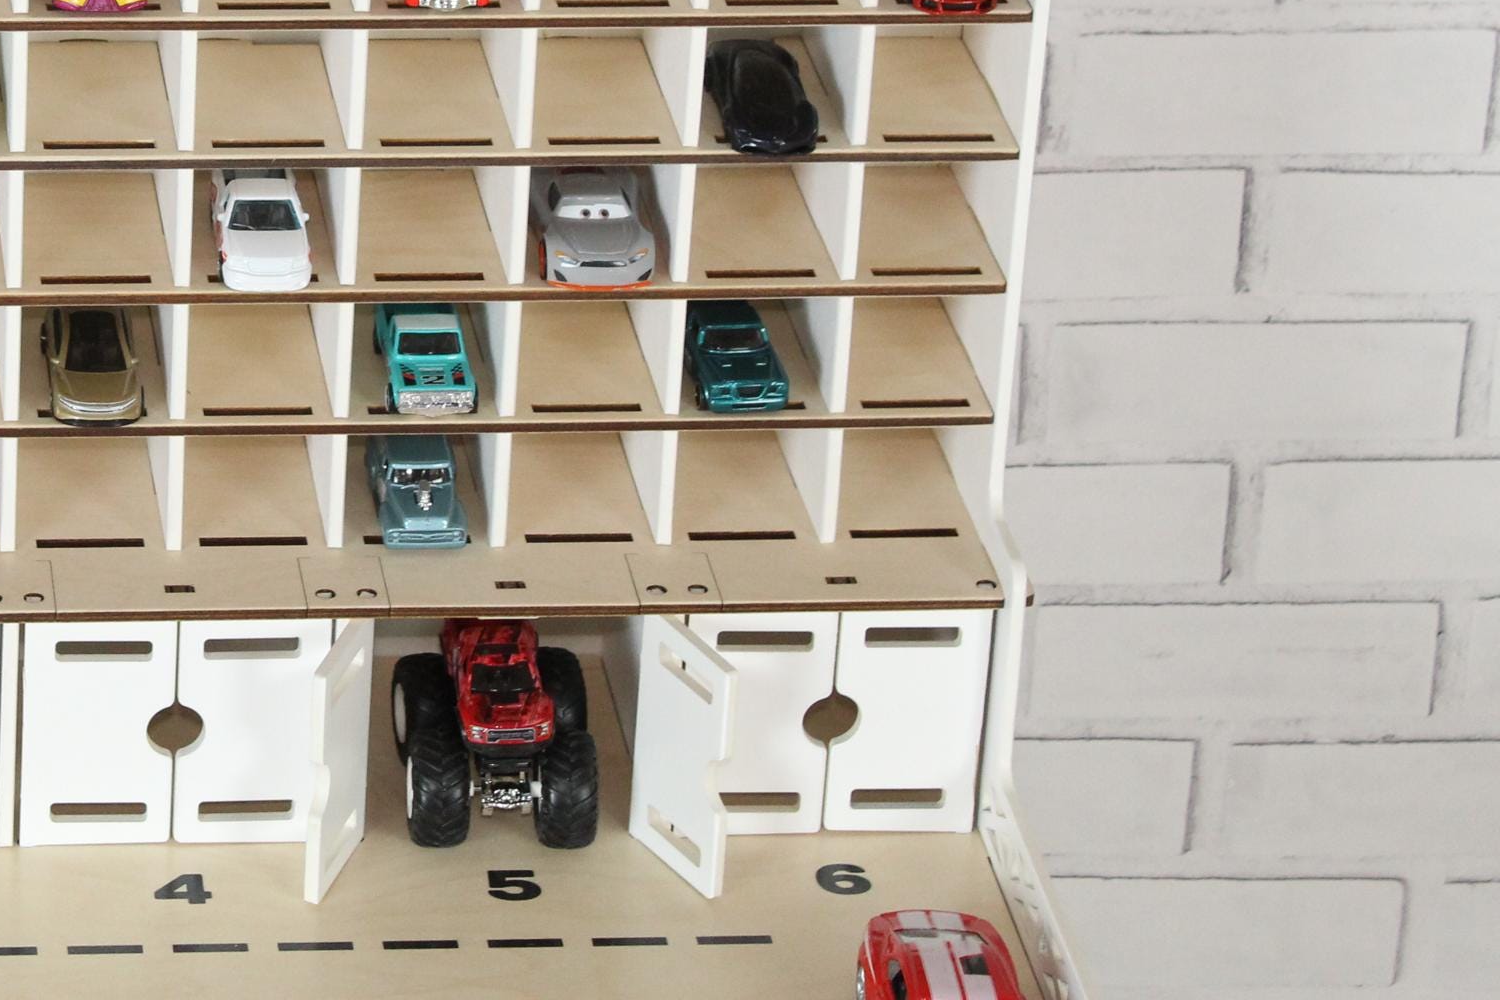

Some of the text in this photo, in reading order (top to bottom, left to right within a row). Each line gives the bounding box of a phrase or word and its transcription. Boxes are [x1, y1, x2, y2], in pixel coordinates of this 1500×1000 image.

[154, 873, 212, 904] 4
[486, 869, 543, 901] 5
[815, 863, 872, 896] 6
